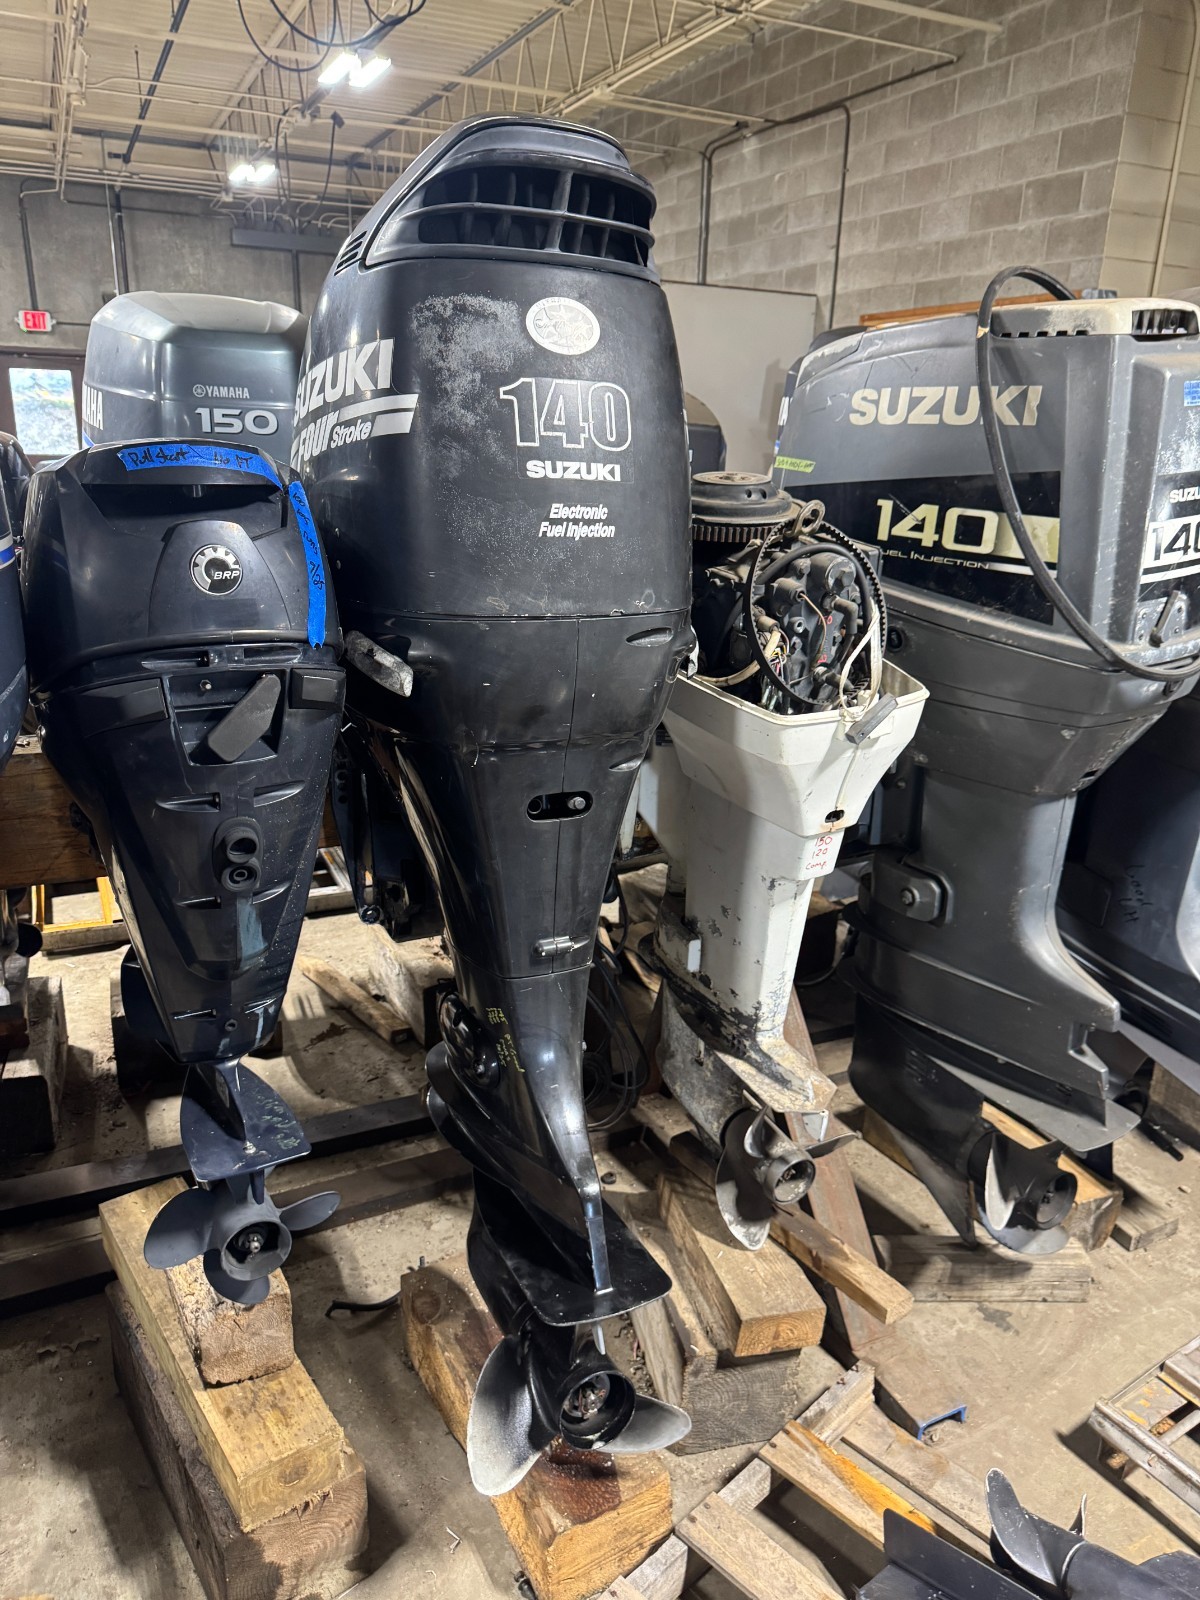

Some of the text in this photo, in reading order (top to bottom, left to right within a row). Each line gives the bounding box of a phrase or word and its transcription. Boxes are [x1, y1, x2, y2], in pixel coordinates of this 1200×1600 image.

[24, 311, 47, 330] EXIT
[205, 385, 251, 399] YAMAHA
[293, 338, 394, 428] SUZUKI
[499, 377, 632, 452] 140
[849, 385, 1043, 426] SUZUKI
[194, 407, 279, 436] 150
[331, 419, 372, 449] Stroke
[128, 447, 154, 467] Pull
[526, 459, 622, 482] SUZUKI
[549, 502, 609, 520] Electronic
[538, 521, 616, 541] Fuel Injection
[876, 498, 1000, 555] 140
[881, 549, 908, 559] UEL
[213, 570, 240, 580] BRP
[815, 836, 833, 847] 150
